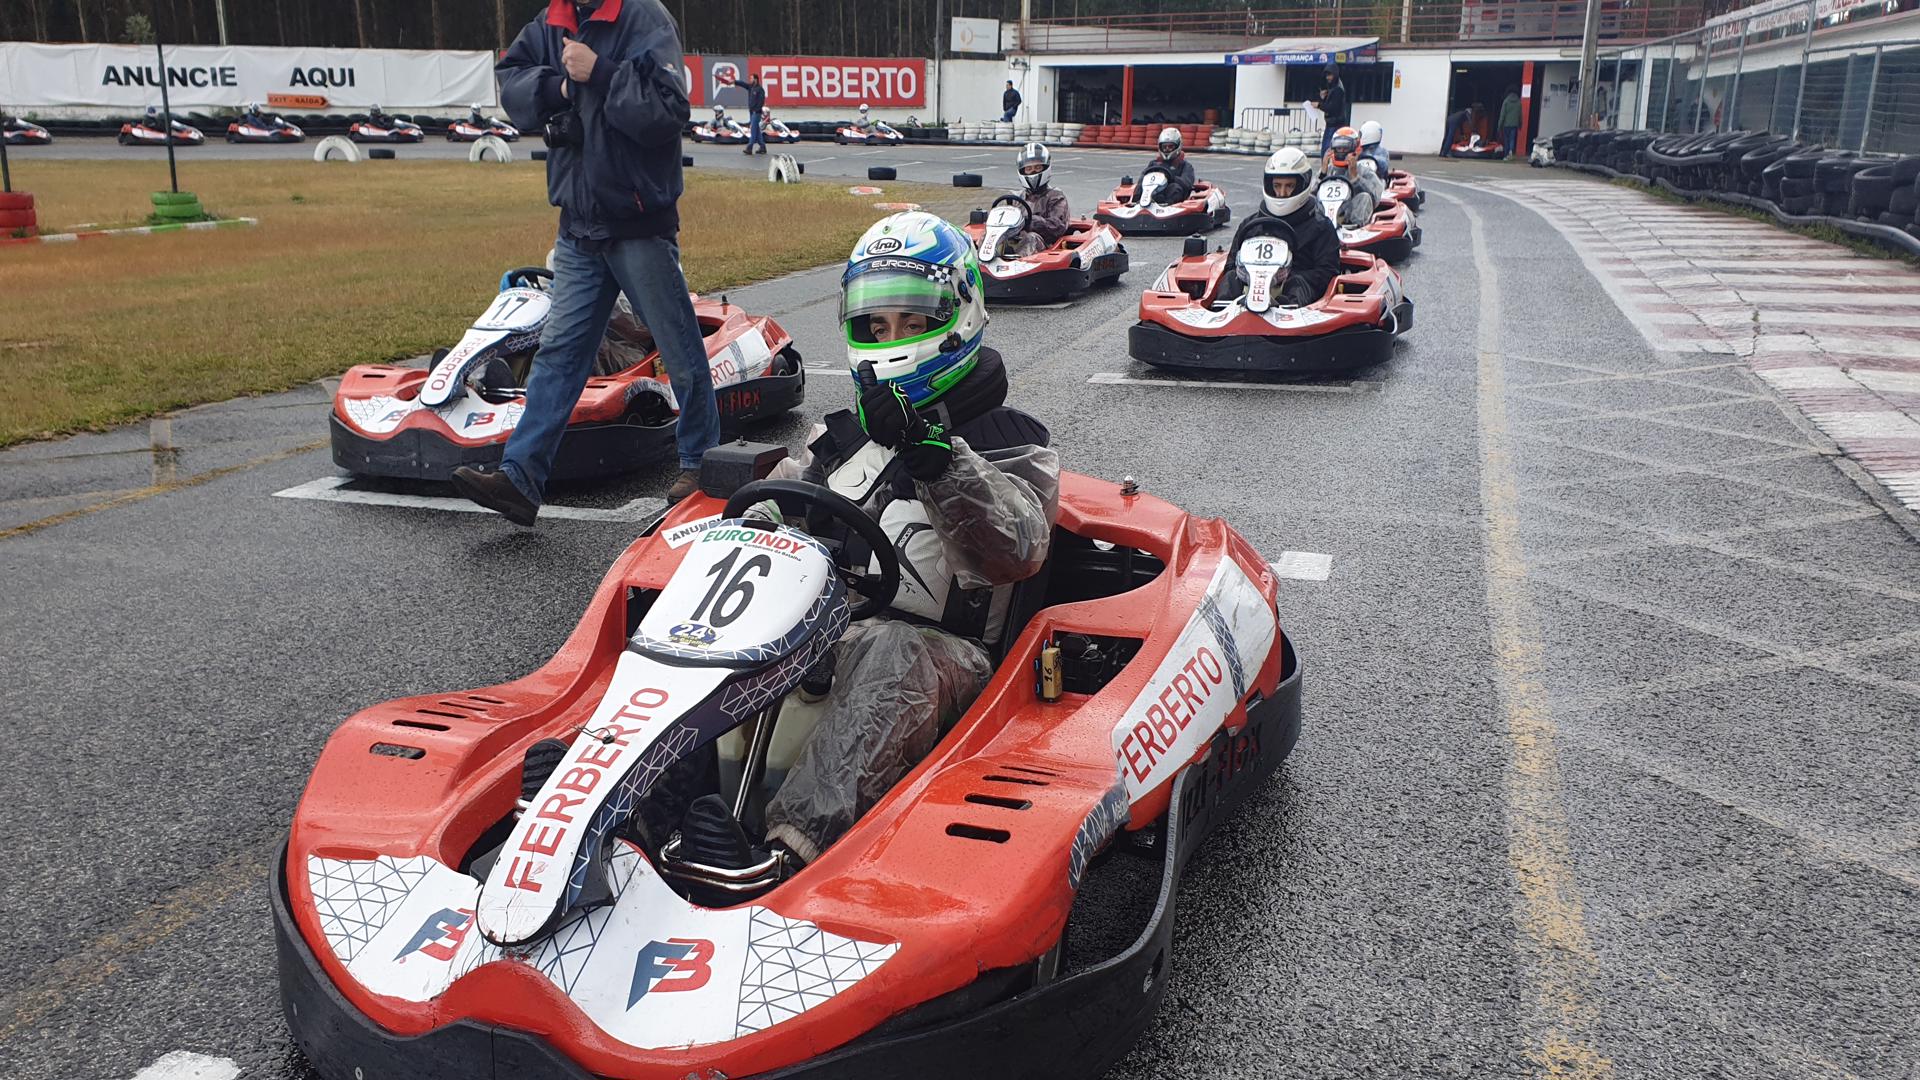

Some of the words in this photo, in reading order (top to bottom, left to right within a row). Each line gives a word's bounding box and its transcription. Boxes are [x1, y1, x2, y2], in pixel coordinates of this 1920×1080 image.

[102, 65, 238, 87] ANUNCIE
[289, 67, 355, 88] AQUI
[761, 65, 917, 99] FERBERTO
[1326, 186, 1341, 198] 25
[999, 210, 1006, 223] 1
[872, 239, 898, 251] Arai
[1255, 243, 1274, 260] 18
[871, 260, 926, 272] EUROPA
[491, 296, 531, 321] 17
[702, 529, 807, 555] EUROINDY
[690, 546, 772, 628] 16
[674, 624, 707, 640] 24
[504, 687, 669, 893] FERBERTO
